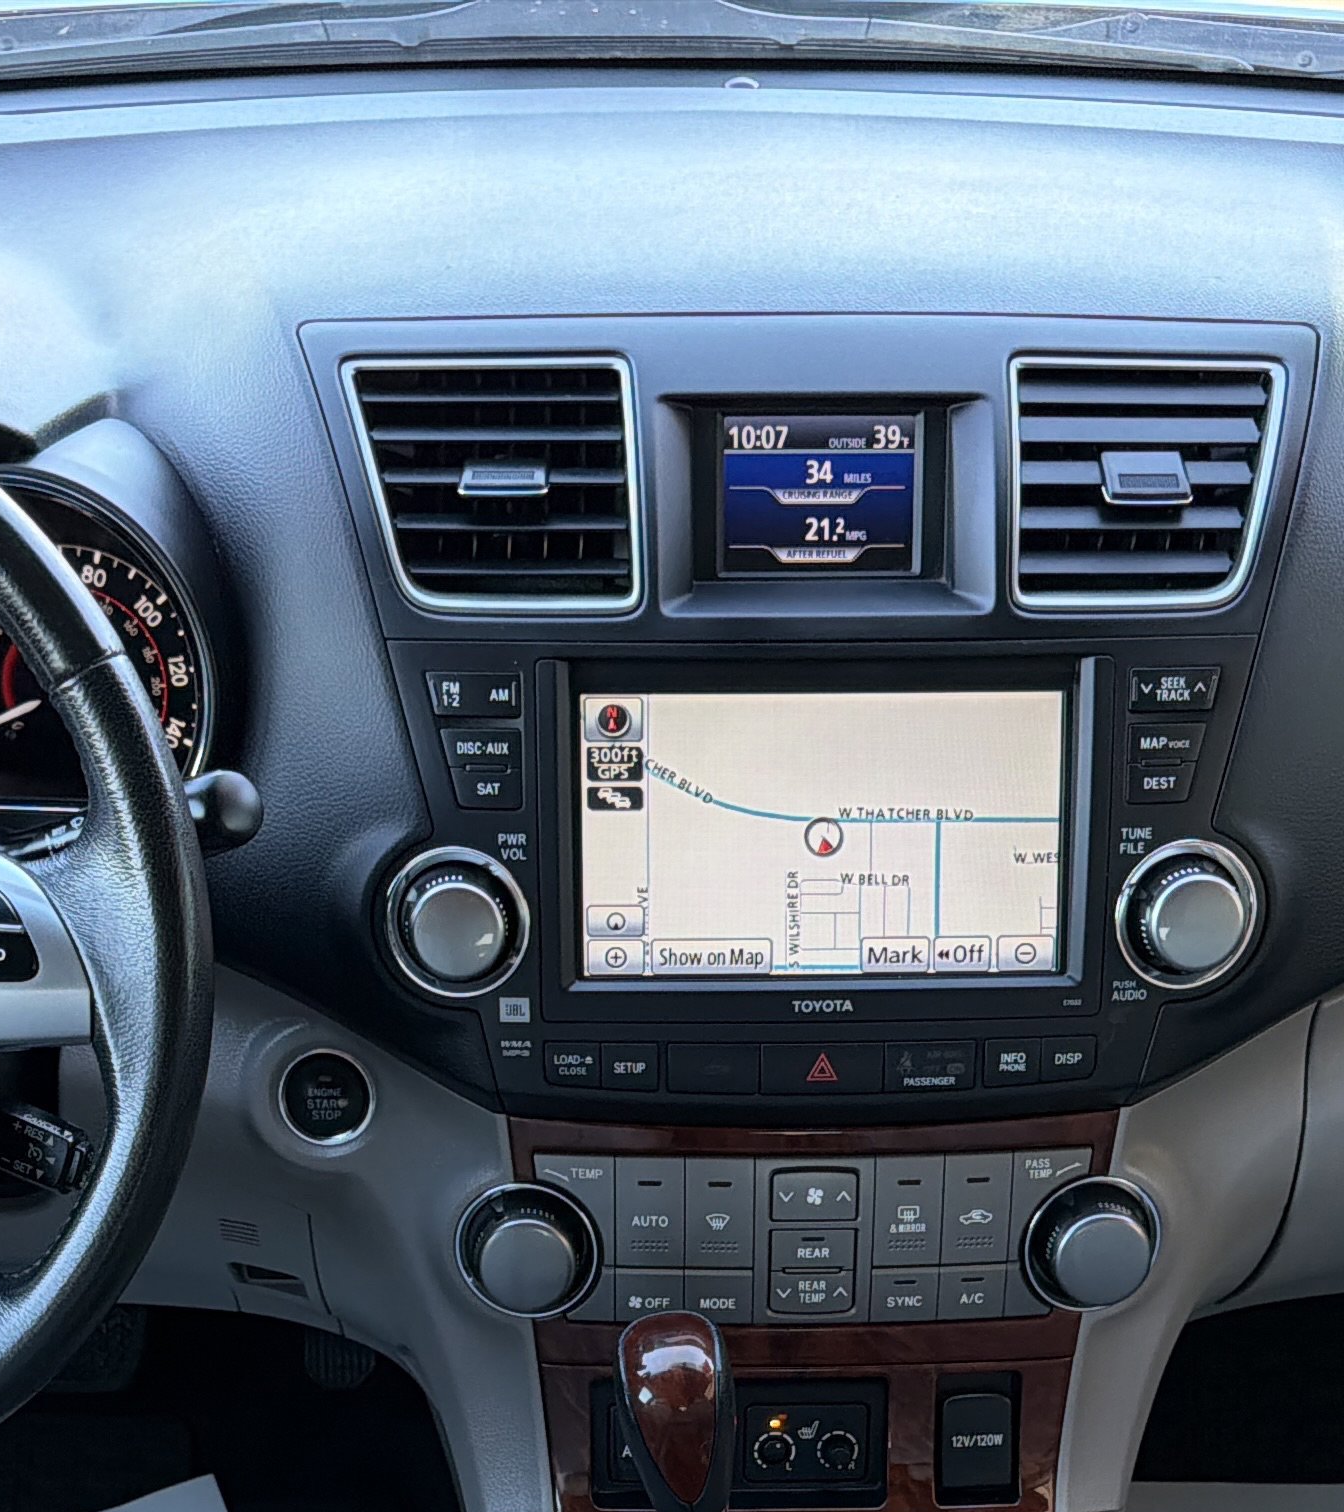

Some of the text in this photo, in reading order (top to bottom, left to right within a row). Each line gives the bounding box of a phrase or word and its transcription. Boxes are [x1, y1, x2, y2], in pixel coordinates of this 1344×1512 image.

[728, 425, 867, 449] 10:07 OUTSIDE
[806, 460, 872, 484] 34 MILES
[782, 490, 853, 500] CRUISING RANGE
[846, 530, 867, 541] MPG
[786, 548, 848, 560] AFTER REFUEL
[81, 564, 107, 588] 80
[134, 595, 162, 628] 100
[167, 655, 189, 688] 120
[442, 682, 460, 694] FM
[1160, 676, 1186, 689] SEEK
[489, 689, 509, 702] AM
[1156, 690, 1190, 701] TRACK
[607, 706, 618, 718] N
[166, 718, 187, 749] 140
[1140, 736, 1168, 750] MAP
[591, 748, 638, 763] 300ft
[598, 766, 629, 780] GPS
[476, 783, 500, 796] SAT
[1143, 778, 1176, 790] DEST
[678, 778, 714, 804] BLVD
[838, 807, 974, 822] W THATCHER BLVD
[498, 834, 526, 845] PWR
[1120, 828, 1152, 840] TUNE
[500, 848, 526, 860] VOL
[1120, 842, 1144, 854] FILE
[1014, 852, 1027, 864] W
[840, 874, 910, 886] W BELL DR
[788, 870, 799, 956] WILSHIRE DR
[659, 948, 764, 968] Show on Map
[867, 945, 924, 964] Mark
[952, 944, 984, 964] Off
[1113, 980, 1136, 988] PUSH
[1112, 990, 1147, 1001] AUDIO
[792, 1000, 854, 1014] TOYOTA
[1000, 1052, 1026, 1064] INFO
[1054, 1053, 1082, 1064] DISP
[558, 1066, 587, 1076] CLOSE
[613, 1062, 646, 1074] SETUP
[999, 1064, 1026, 1072] PHONE
[904, 1076, 956, 1086] PASSENGER
[308, 1088, 342, 1097] ENGINE
[312, 1110, 342, 1121] STOP
[24, 1125, 45, 1140] RES
[13, 1160, 34, 1174] SET
[1026, 1158, 1050, 1169] PASS
[572, 1168, 603, 1180] TEMP
[1029, 1168, 1052, 1179] TEMP
[632, 1216, 668, 1228] AUTO
[898, 1223, 926, 1233] MIRROR
[797, 1248, 830, 1259] REAR
[798, 1280, 826, 1292] REAR
[644, 1298, 670, 1309] OFF
[700, 1298, 736, 1310] MODE
[799, 1292, 826, 1304] TEMP
[886, 1296, 922, 1308] SYNC
[960, 1292, 984, 1304] A/C
[952, 1434, 1004, 1448] 12V/120W
